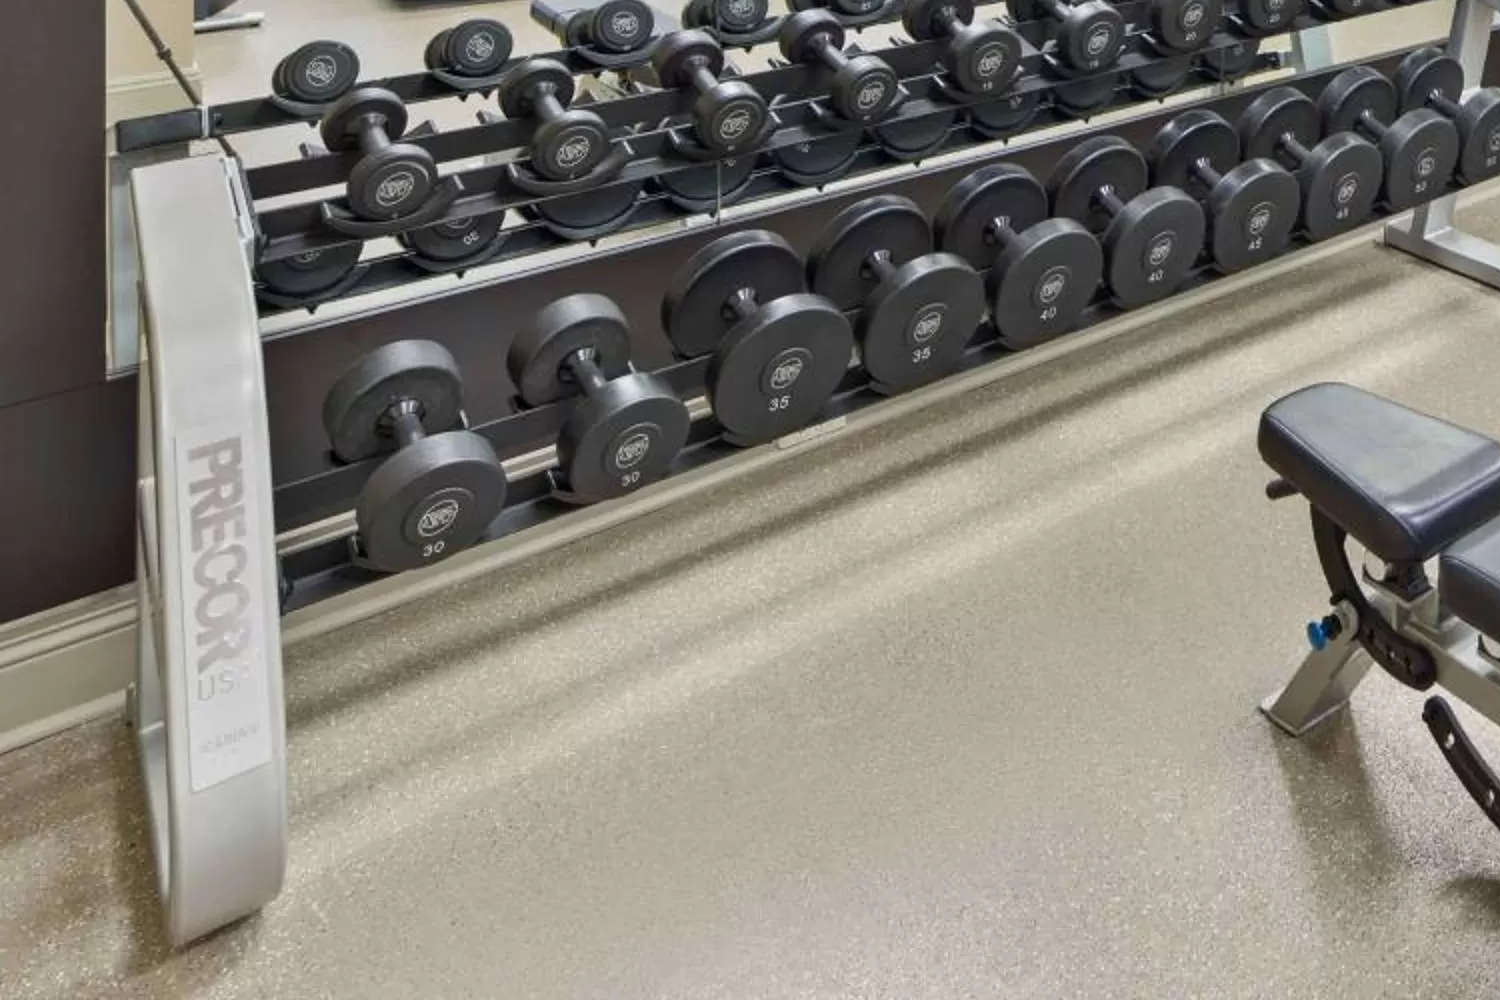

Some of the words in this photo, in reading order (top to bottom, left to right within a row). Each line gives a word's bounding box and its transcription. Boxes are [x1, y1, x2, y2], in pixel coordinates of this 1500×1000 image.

[1149, 268, 1164, 283] 40
[1040, 305, 1058, 322] 40
[911, 346, 932, 364] 35
[767, 395, 791, 413] 35
[621, 470, 641, 488] 30
[187, 435, 252, 676] PRECOR
[422, 540, 446, 558] 30
